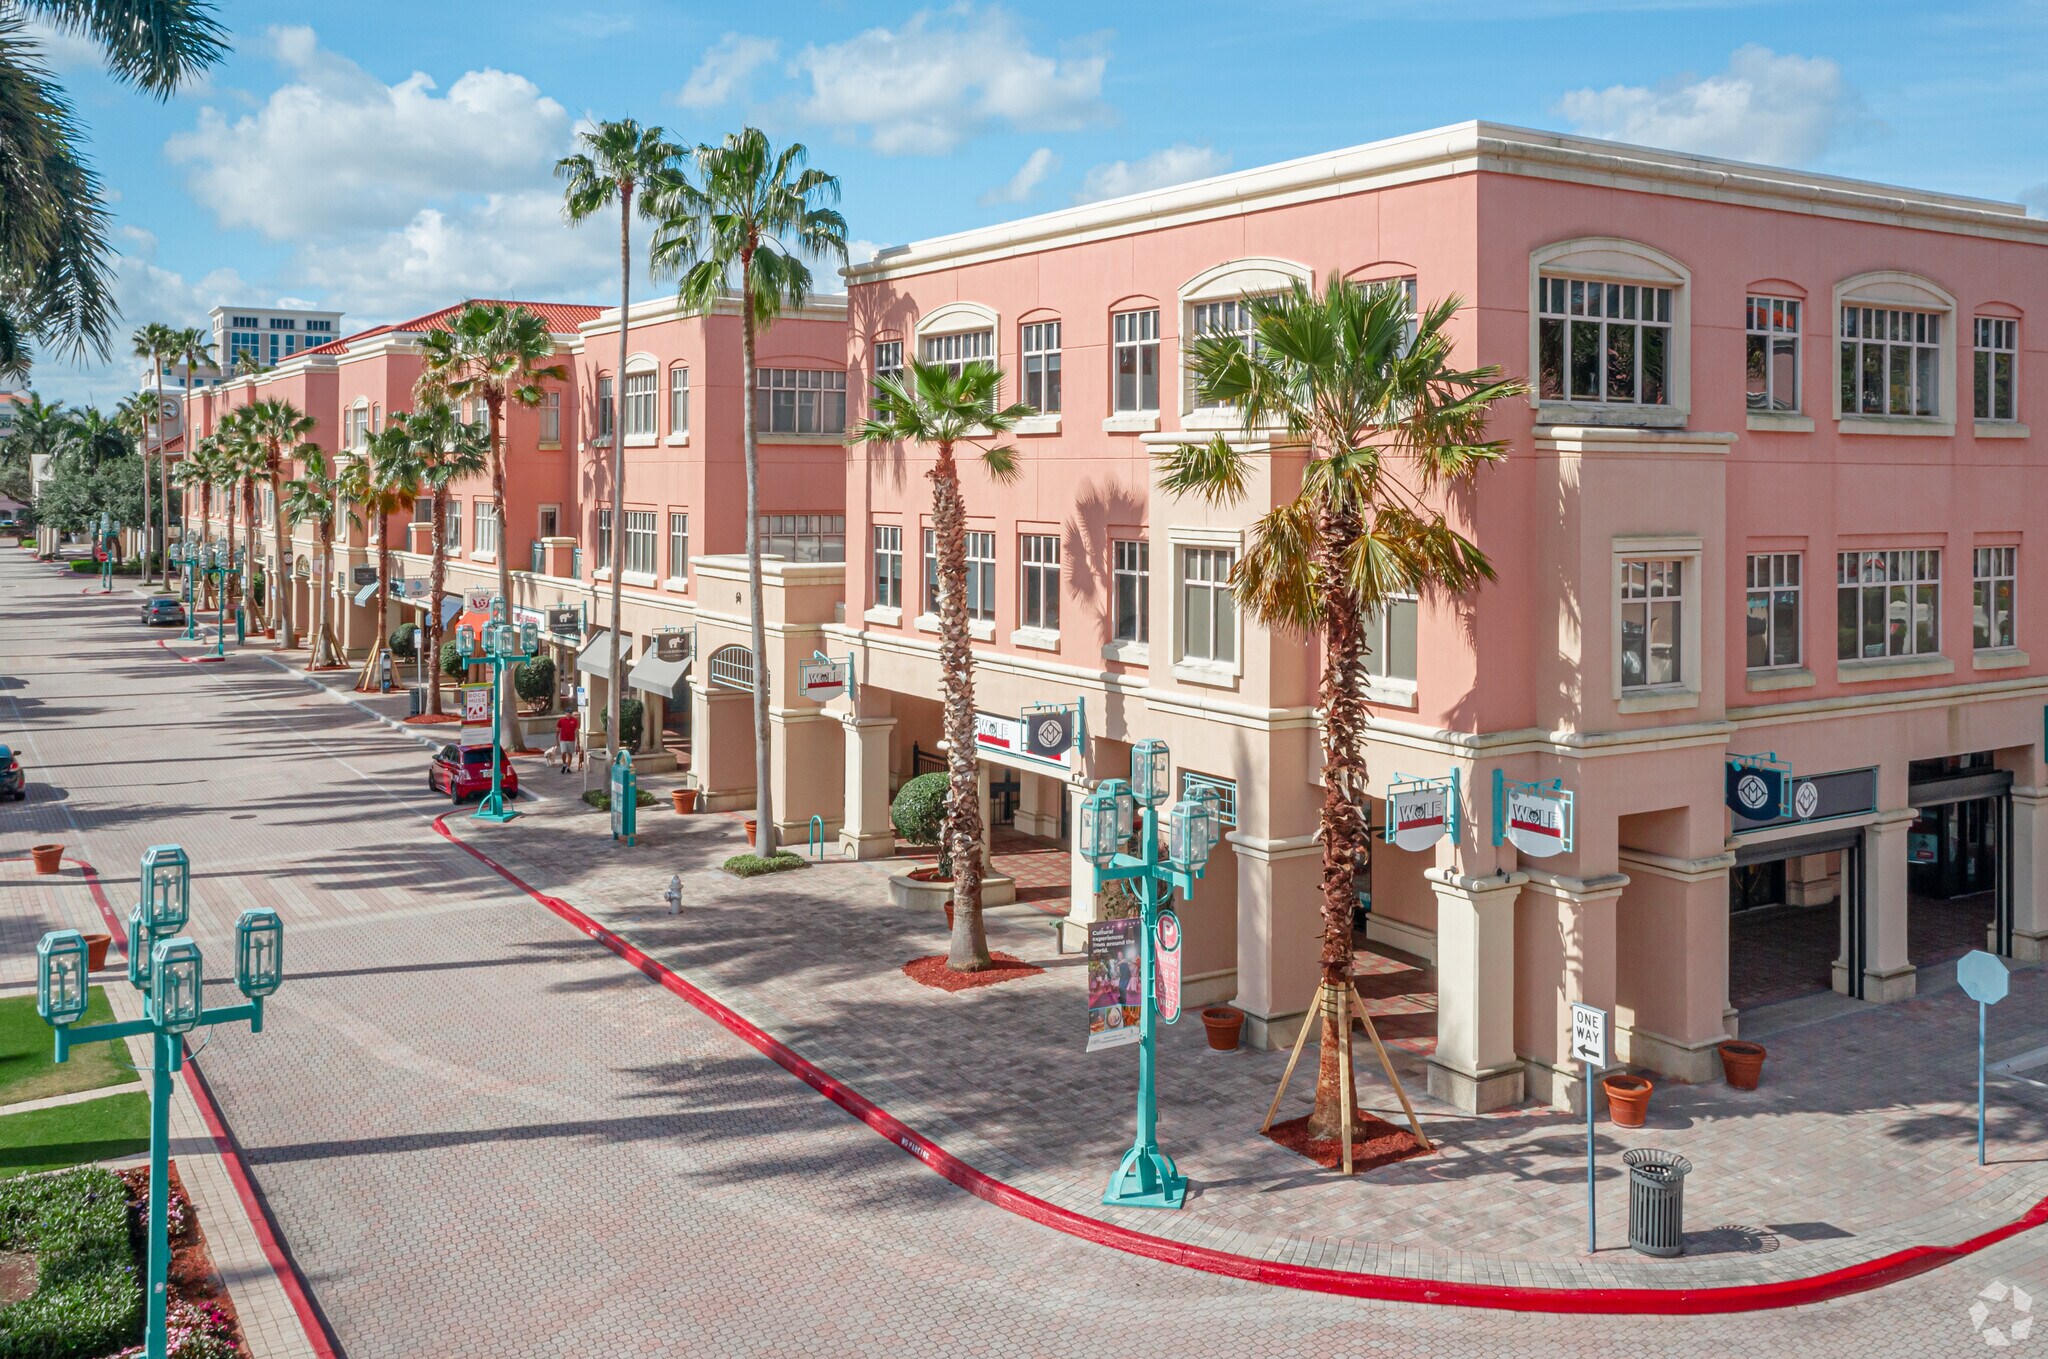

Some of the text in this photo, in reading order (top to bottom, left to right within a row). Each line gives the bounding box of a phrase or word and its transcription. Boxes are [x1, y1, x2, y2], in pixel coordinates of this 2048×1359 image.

[1162, 920, 1174, 941] P
[1157, 951, 1177, 967] PARKING
[1159, 997, 1175, 1009] VALET
[1577, 1011, 1599, 1029] ONE
[1576, 1025, 1600, 1044] WAY
